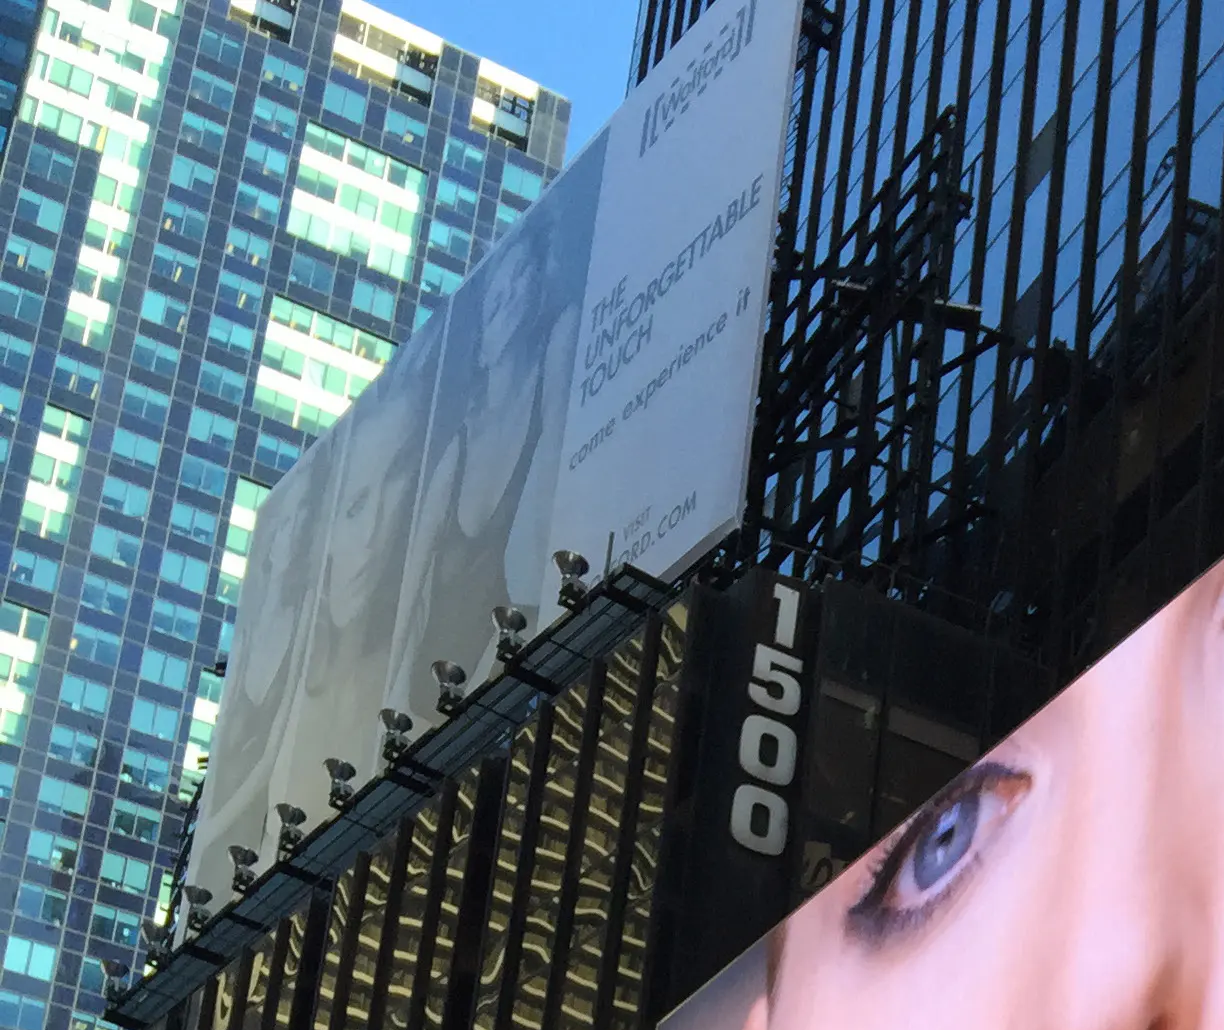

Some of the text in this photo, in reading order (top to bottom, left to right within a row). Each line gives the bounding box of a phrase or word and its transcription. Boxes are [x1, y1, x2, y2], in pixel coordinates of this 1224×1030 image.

[580, 313, 654, 407] TOUCH
[584, 172, 764, 370] UNFORGETTABLE
[590, 273, 629, 333] THE
[568, 285, 751, 471] come experience it
[730, 582, 804, 856] 1500
